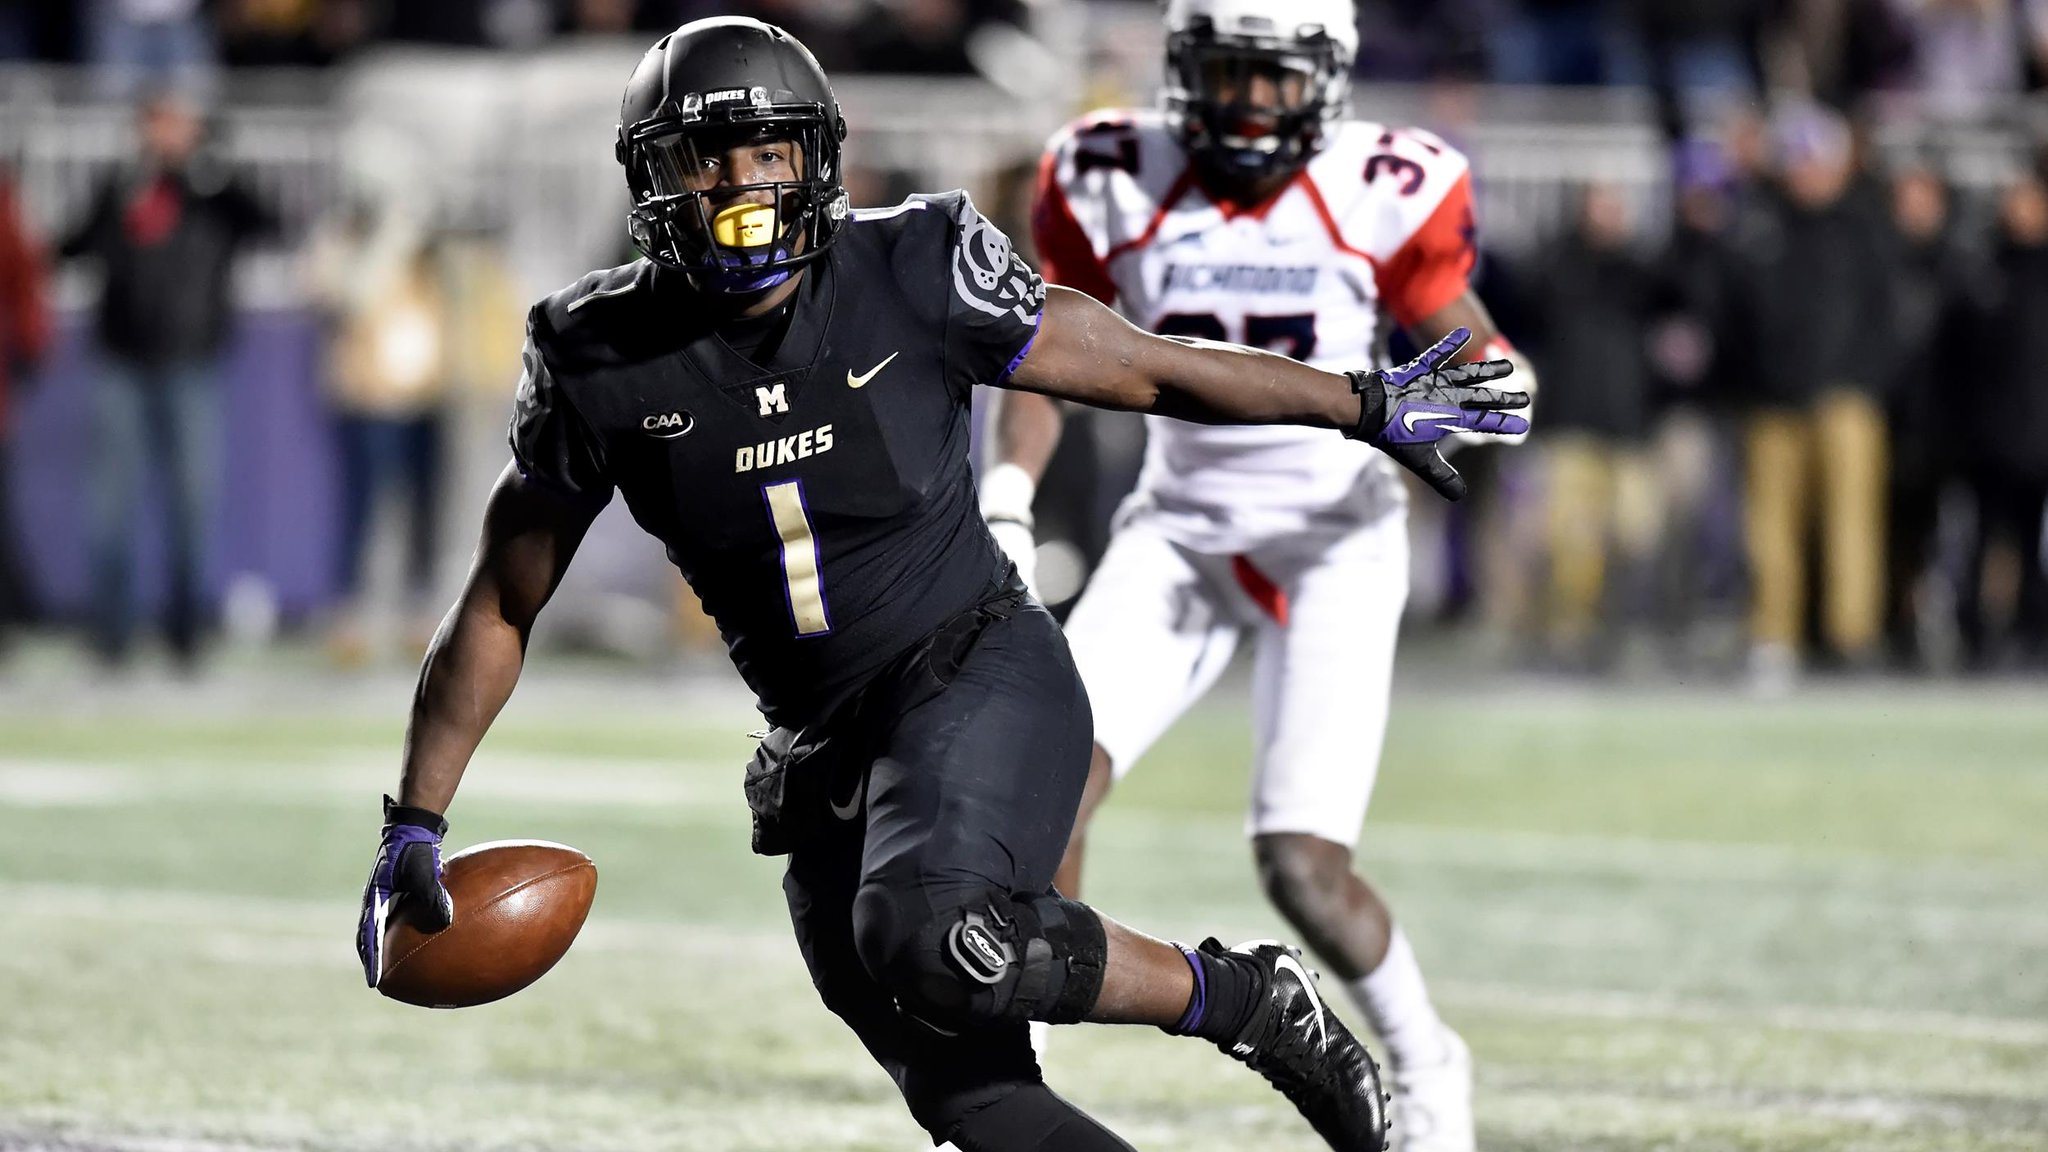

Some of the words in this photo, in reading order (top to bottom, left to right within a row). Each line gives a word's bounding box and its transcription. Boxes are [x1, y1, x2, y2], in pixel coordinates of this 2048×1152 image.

[705, 89, 746, 105] DUKES
[755, 382, 790, 417] M
[643, 412, 684, 431] CAA
[735, 423, 835, 474] DUKES
[760, 478, 834, 639] 1
